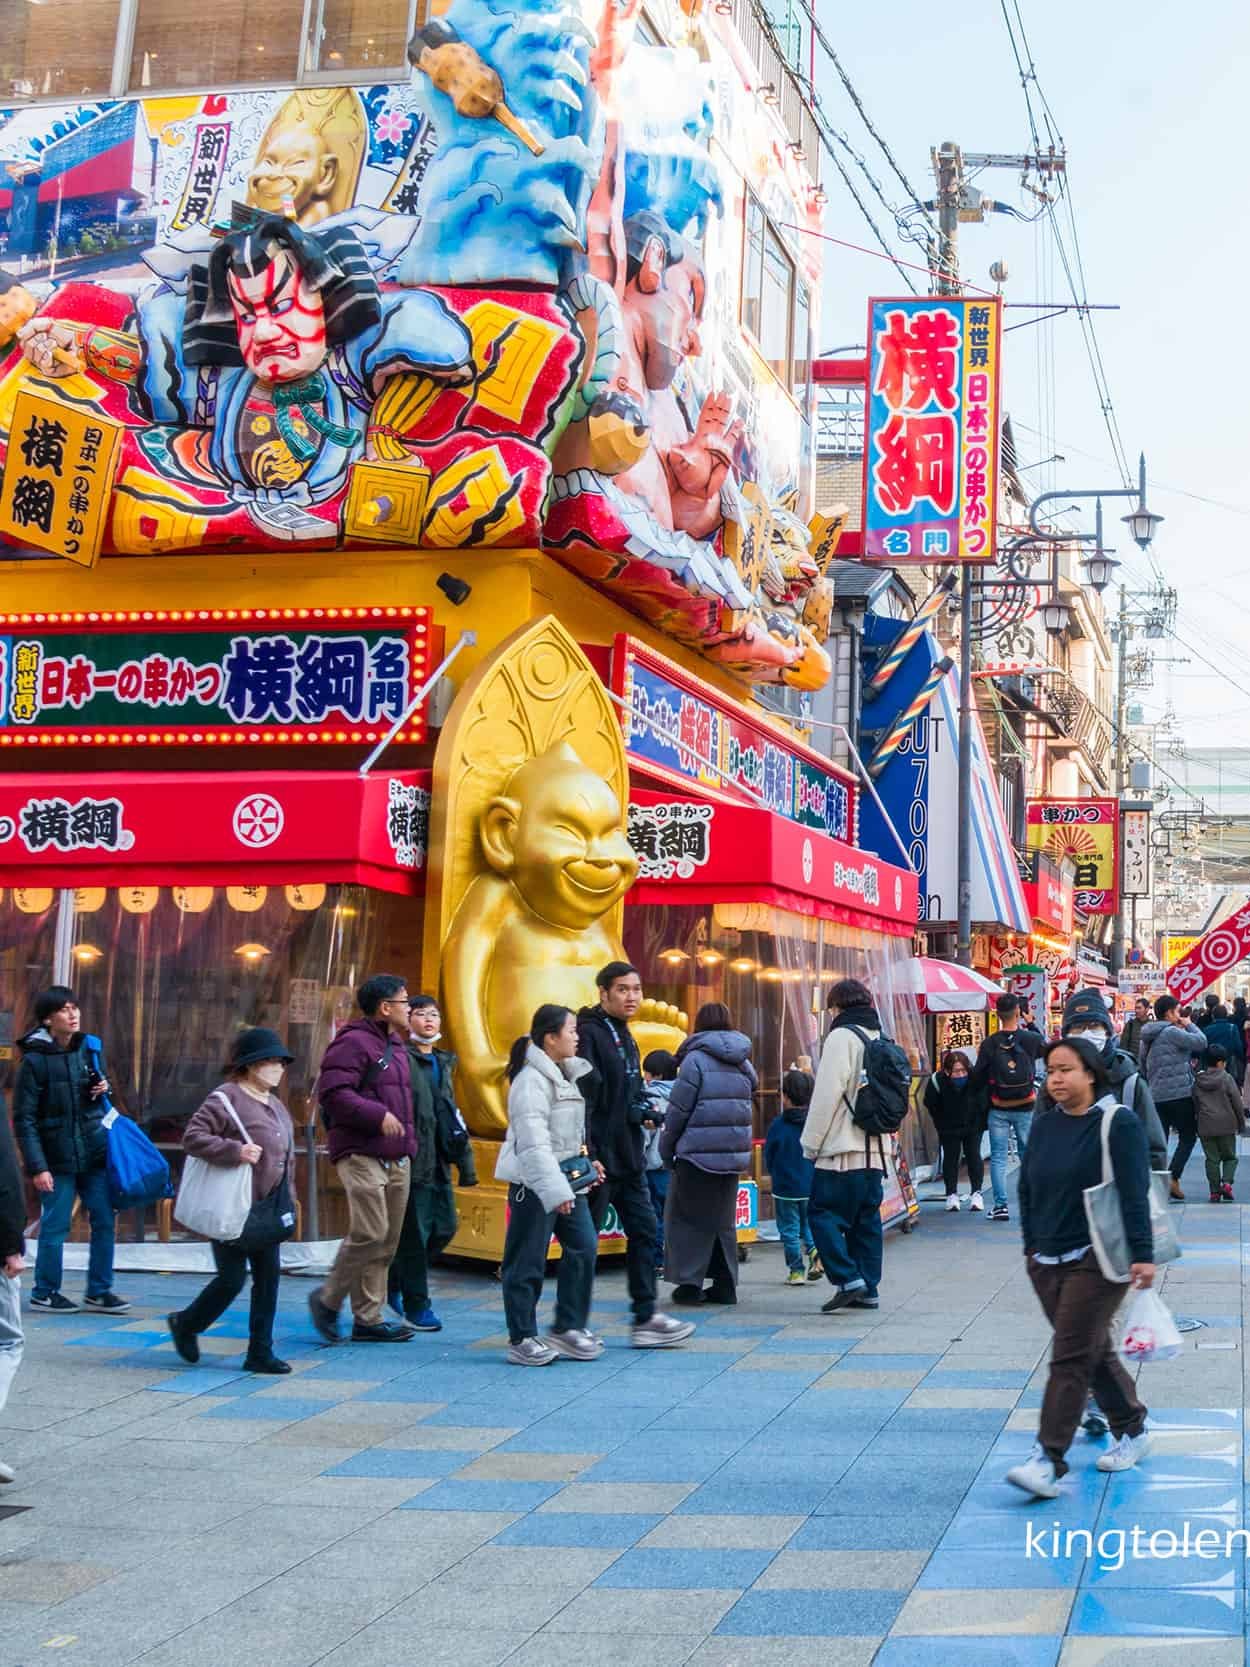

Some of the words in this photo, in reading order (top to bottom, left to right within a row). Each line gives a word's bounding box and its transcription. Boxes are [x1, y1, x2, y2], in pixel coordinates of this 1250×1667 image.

[182, 128, 226, 223] 新世界
[968, 306, 990, 367] 新世界
[876, 311, 959, 513] 横綱
[13, 414, 69, 534] 横綱
[64, 427, 103, 554] 日本一の串かつ
[965, 374, 989, 554] 日本一の串かつ
[885, 530, 949, 556] 名門
[14, 645, 39, 719] 新世界
[42, 655, 221, 707] 日本一の串かつ
[223, 639, 366, 721] 横綱
[369, 643, 407, 720] 名門
[679, 695, 712, 779] 横綱
[21, 800, 120, 849] 横綱
[1042, 807, 1101, 823] 串かつ
[735, 1189, 750, 1225] 名門
